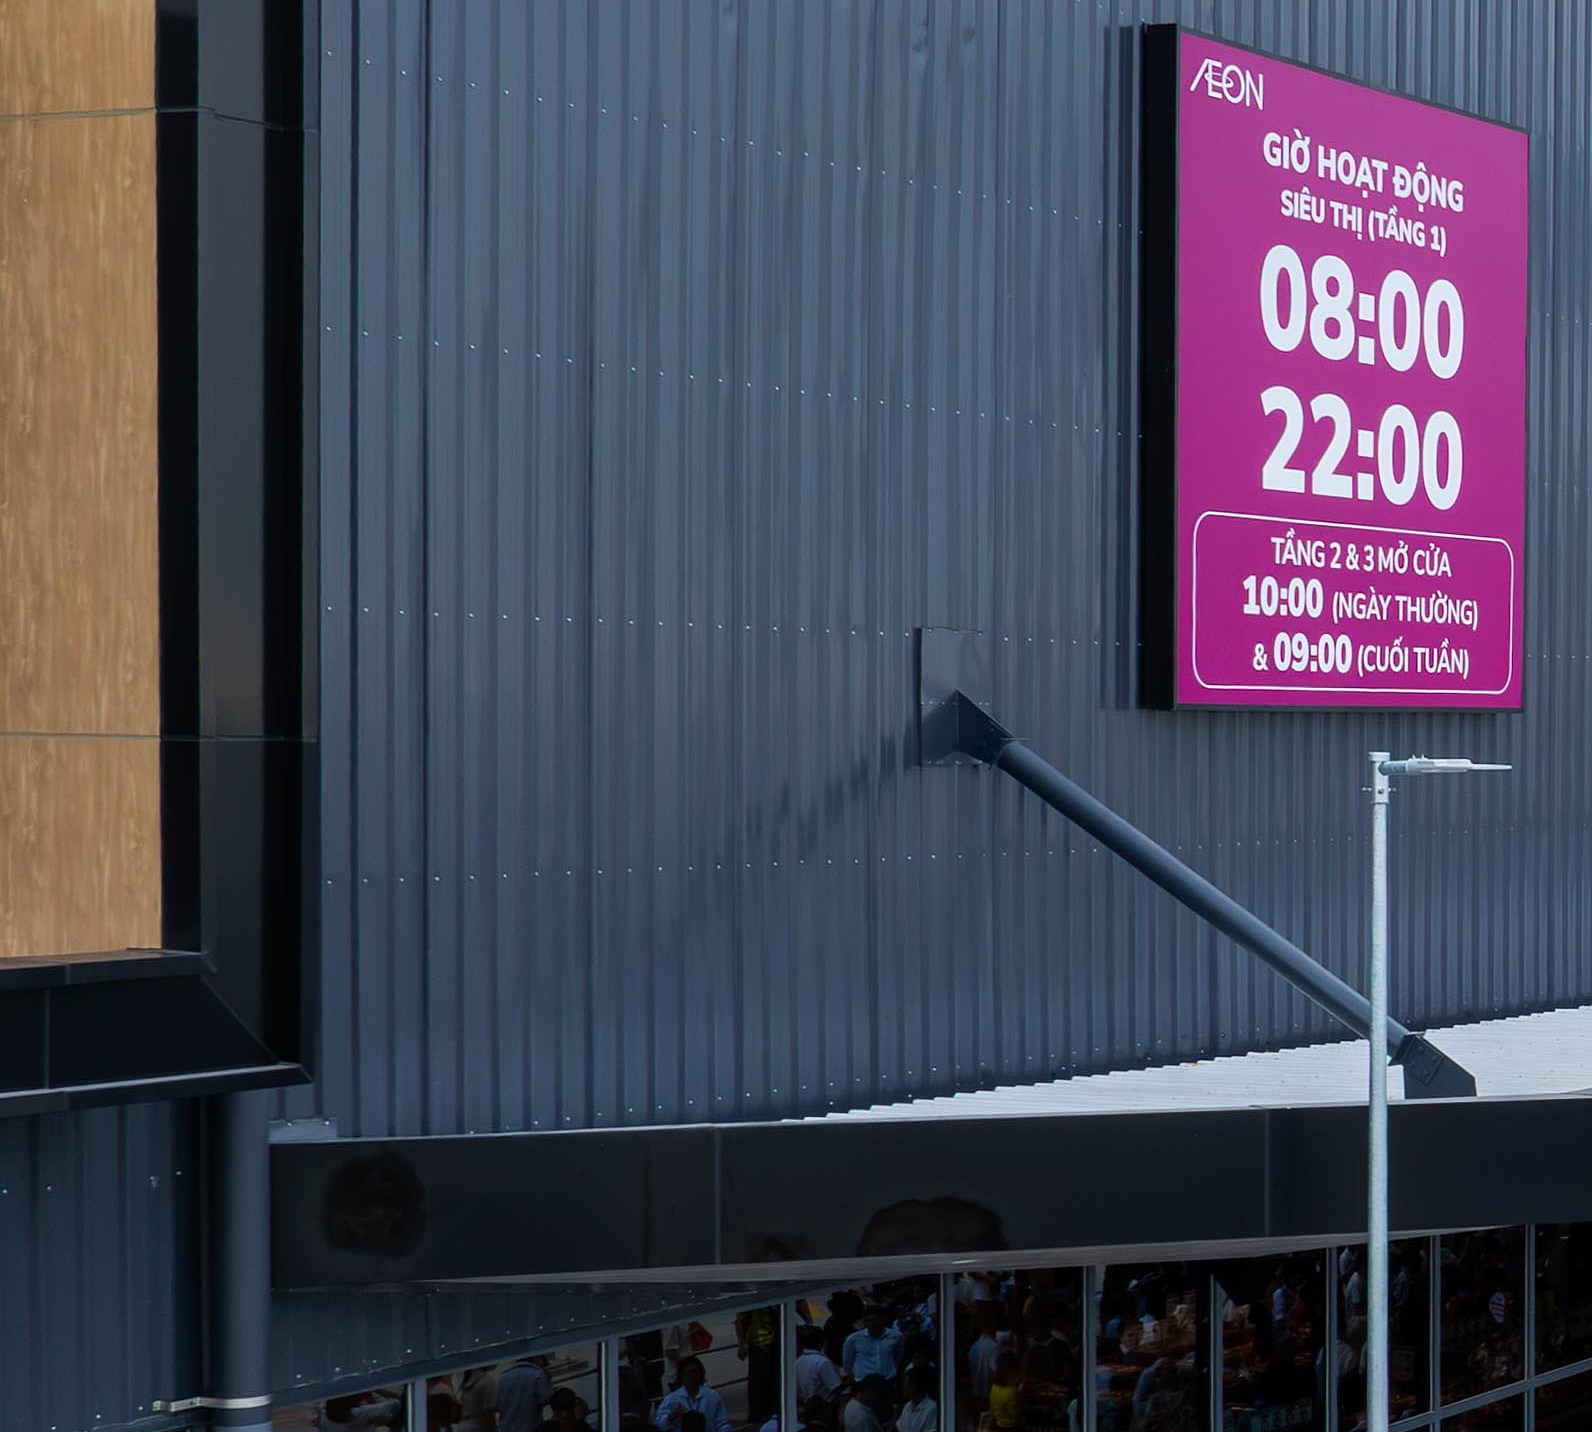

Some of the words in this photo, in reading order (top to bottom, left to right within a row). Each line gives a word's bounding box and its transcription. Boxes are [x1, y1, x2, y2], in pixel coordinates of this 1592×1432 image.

[1263, 130, 1310, 175] GIỜ
[1317, 148, 1387, 199] HOẠT
[1391, 163, 1464, 213] ĐỘNG
[1280, 189, 1325, 226] SIÊU
[1331, 199, 1363, 242] THỊ
[1367, 205, 1425, 249] (TẦNG
[1430, 225, 1447, 256] 1)
[1260, 245, 1464, 380] 08:00
[1261, 385, 1463, 511] 22:00
[1271, 529, 1325, 570] TẦNG
[1329, 543, 1342, 570] 2
[1345, 545, 1359, 571] &
[1363, 546, 1374, 572] 3
[1378, 545, 1408, 577] MỞ
[1413, 542, 1451, 578] CỬA
[1242, 575, 1323, 620] 10:00
[1332, 590, 1392, 624] (NGÀY
[1395, 590, 1478, 631] THƯỜNG)
[1253, 645, 1268, 672] &
[1274, 633, 1352, 675] 09:00
[1358, 633, 1409, 677] (CUỐI
[1413, 635, 1469, 681] TUẦN)
